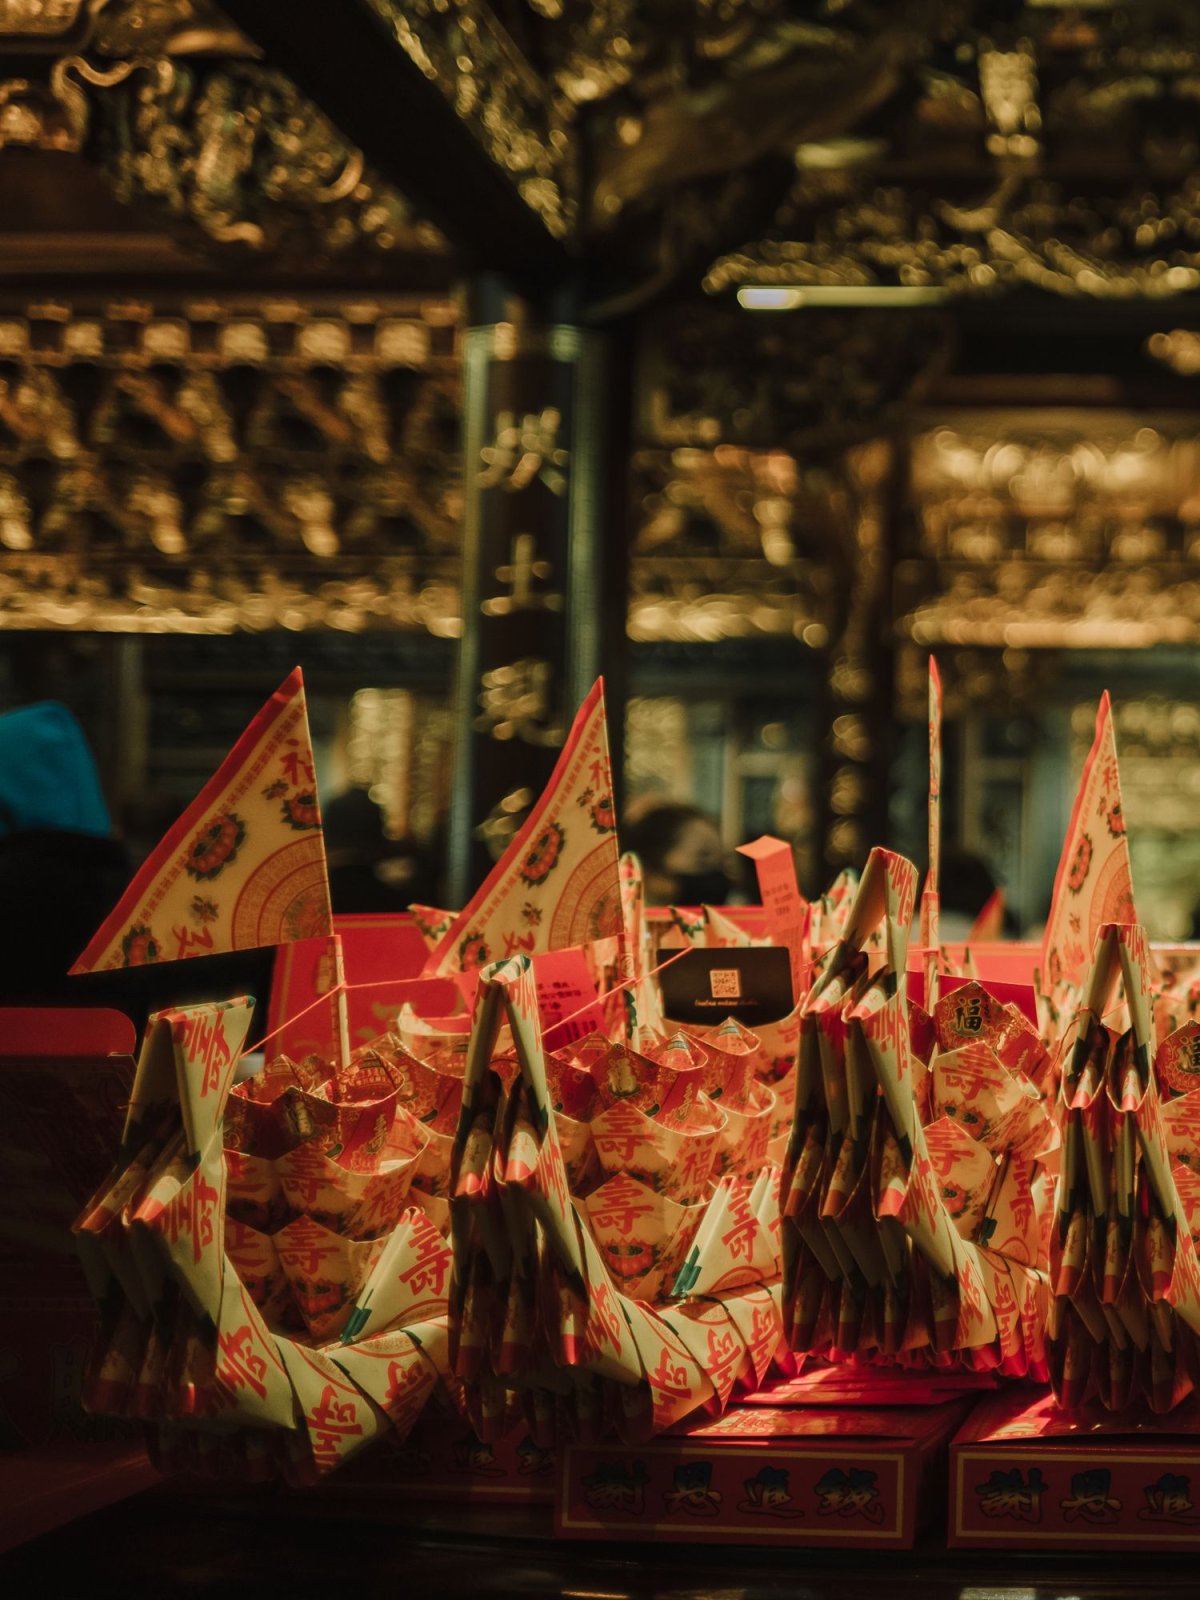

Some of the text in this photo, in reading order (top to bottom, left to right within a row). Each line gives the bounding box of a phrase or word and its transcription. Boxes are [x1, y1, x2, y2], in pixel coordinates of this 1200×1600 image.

[955, 998, 984, 1032] 福
[940, 1045, 1003, 1099] 壽
[593, 1101, 656, 1161] 壽
[281, 1142, 339, 1205] 壽
[590, 1174, 655, 1235] 壽
[277, 1214, 340, 1275] 壽
[722, 1176, 760, 1262] 壽
[399, 1209, 454, 1296] 壽
[703, 1327, 742, 1411] 壽
[305, 1384, 363, 1468] 壽
